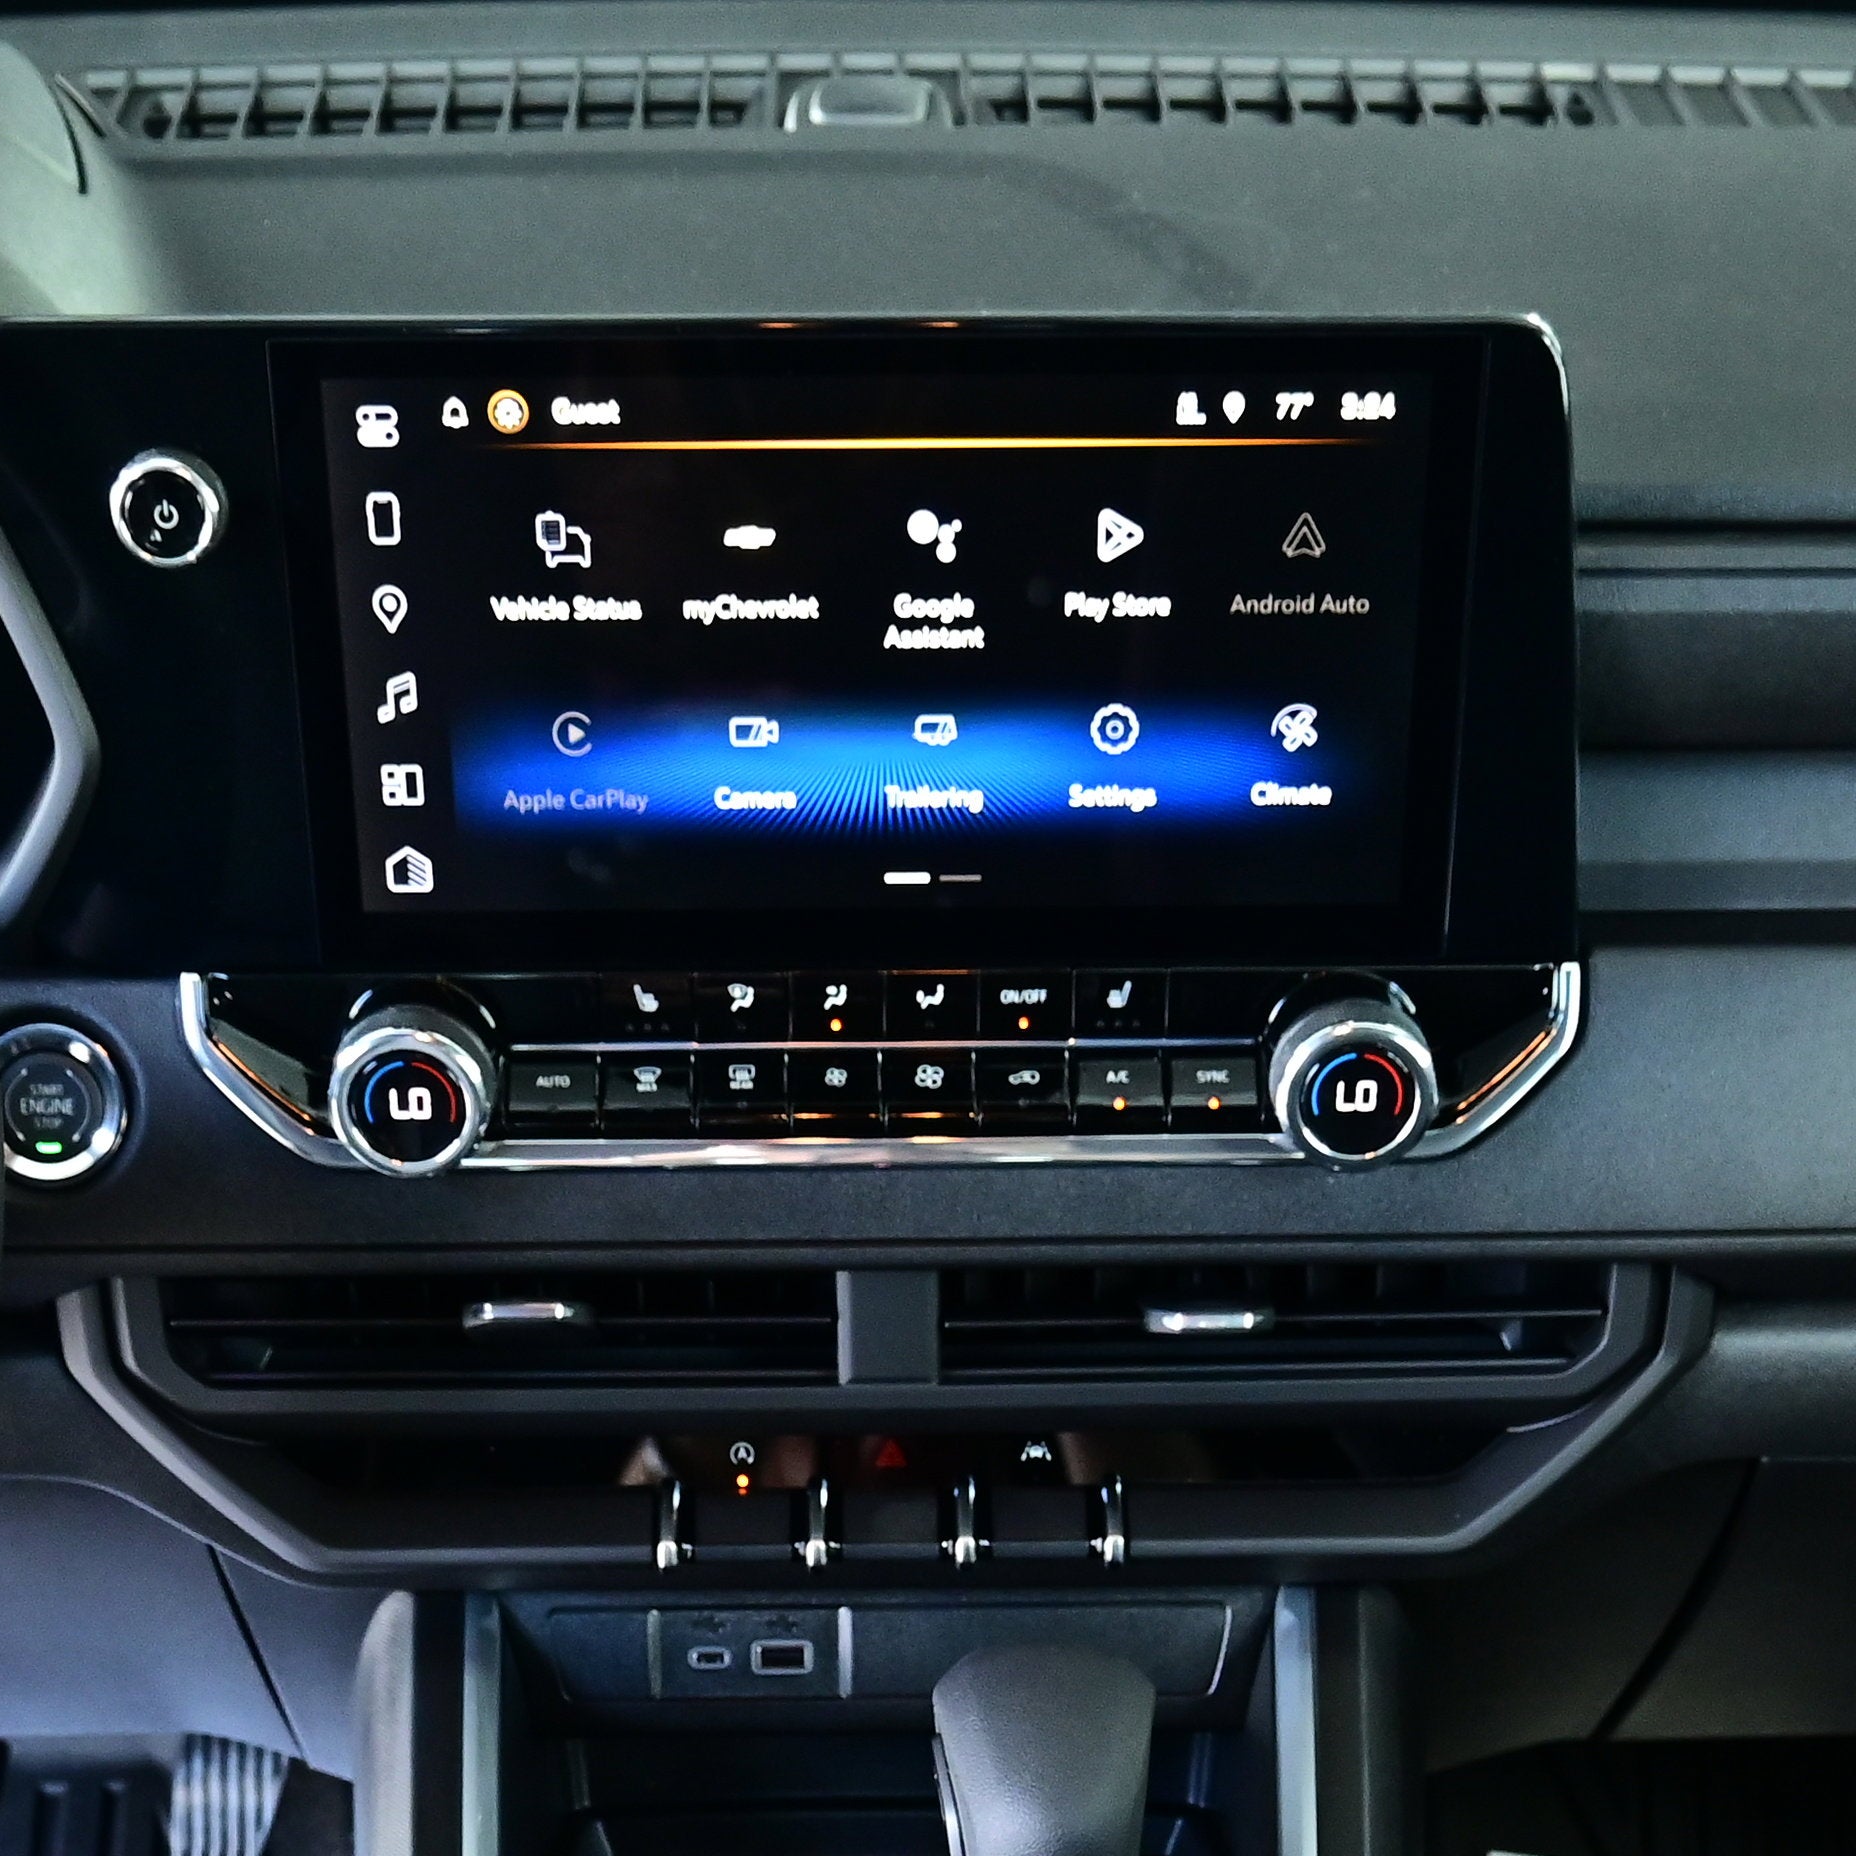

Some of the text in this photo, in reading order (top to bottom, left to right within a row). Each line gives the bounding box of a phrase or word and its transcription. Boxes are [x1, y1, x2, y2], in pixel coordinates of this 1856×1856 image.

[551, 396, 621, 426] Guest
[489, 594, 643, 621] Vehicle Status
[682, 593, 820, 626] myChevrolet
[893, 592, 974, 624] Google
[1064, 591, 1172, 623] Play Store
[1229, 592, 1370, 615] Android Auto
[883, 624, 985, 649] Assistant
[503, 788, 649, 815] Apple CarPlay
[714, 785, 798, 810] Camera
[884, 785, 985, 813] Trailering
[1068, 783, 1158, 812] Settings
[1250, 781, 1333, 806] Climate
[1000, 988, 1047, 1004] ON/OFF
[535, 1074, 571, 1088] AUTO
[1105, 1070, 1130, 1084] A/C
[1196, 1070, 1230, 1084] SYNC
[20, 1098, 74, 1117] ENGINE
[388, 1086, 432, 1121] LO
[1334, 1079, 1378, 1113] LO
